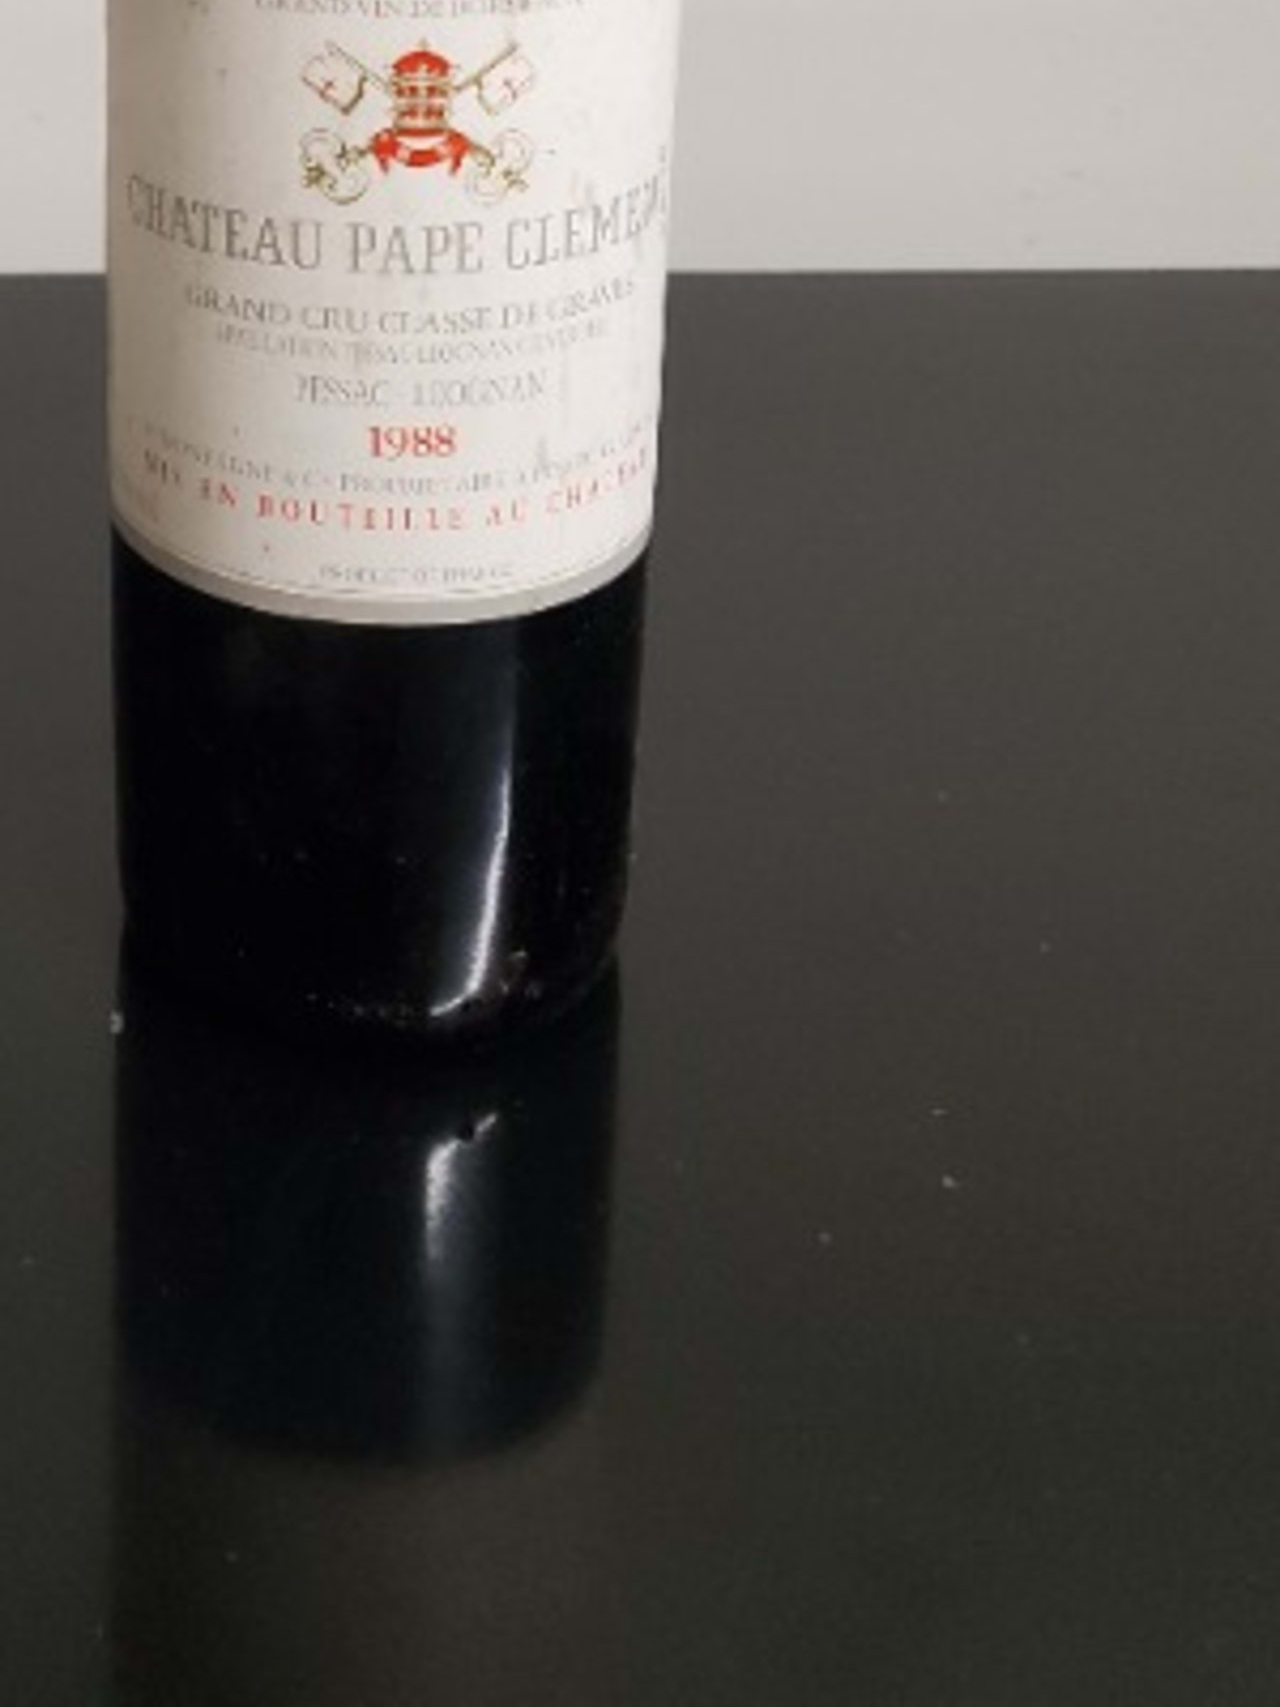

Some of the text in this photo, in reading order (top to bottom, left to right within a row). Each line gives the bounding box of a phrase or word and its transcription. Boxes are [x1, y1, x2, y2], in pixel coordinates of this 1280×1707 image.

[347, 221, 484, 276] PAPE
[186, 286, 291, 325] GRAND
[301, 306, 369, 333] CRU
[368, 423, 458, 462] 1988
[198, 477, 238, 508] EN
[257, 493, 466, 532] BOUTEILLE
[484, 499, 529, 526] AU
